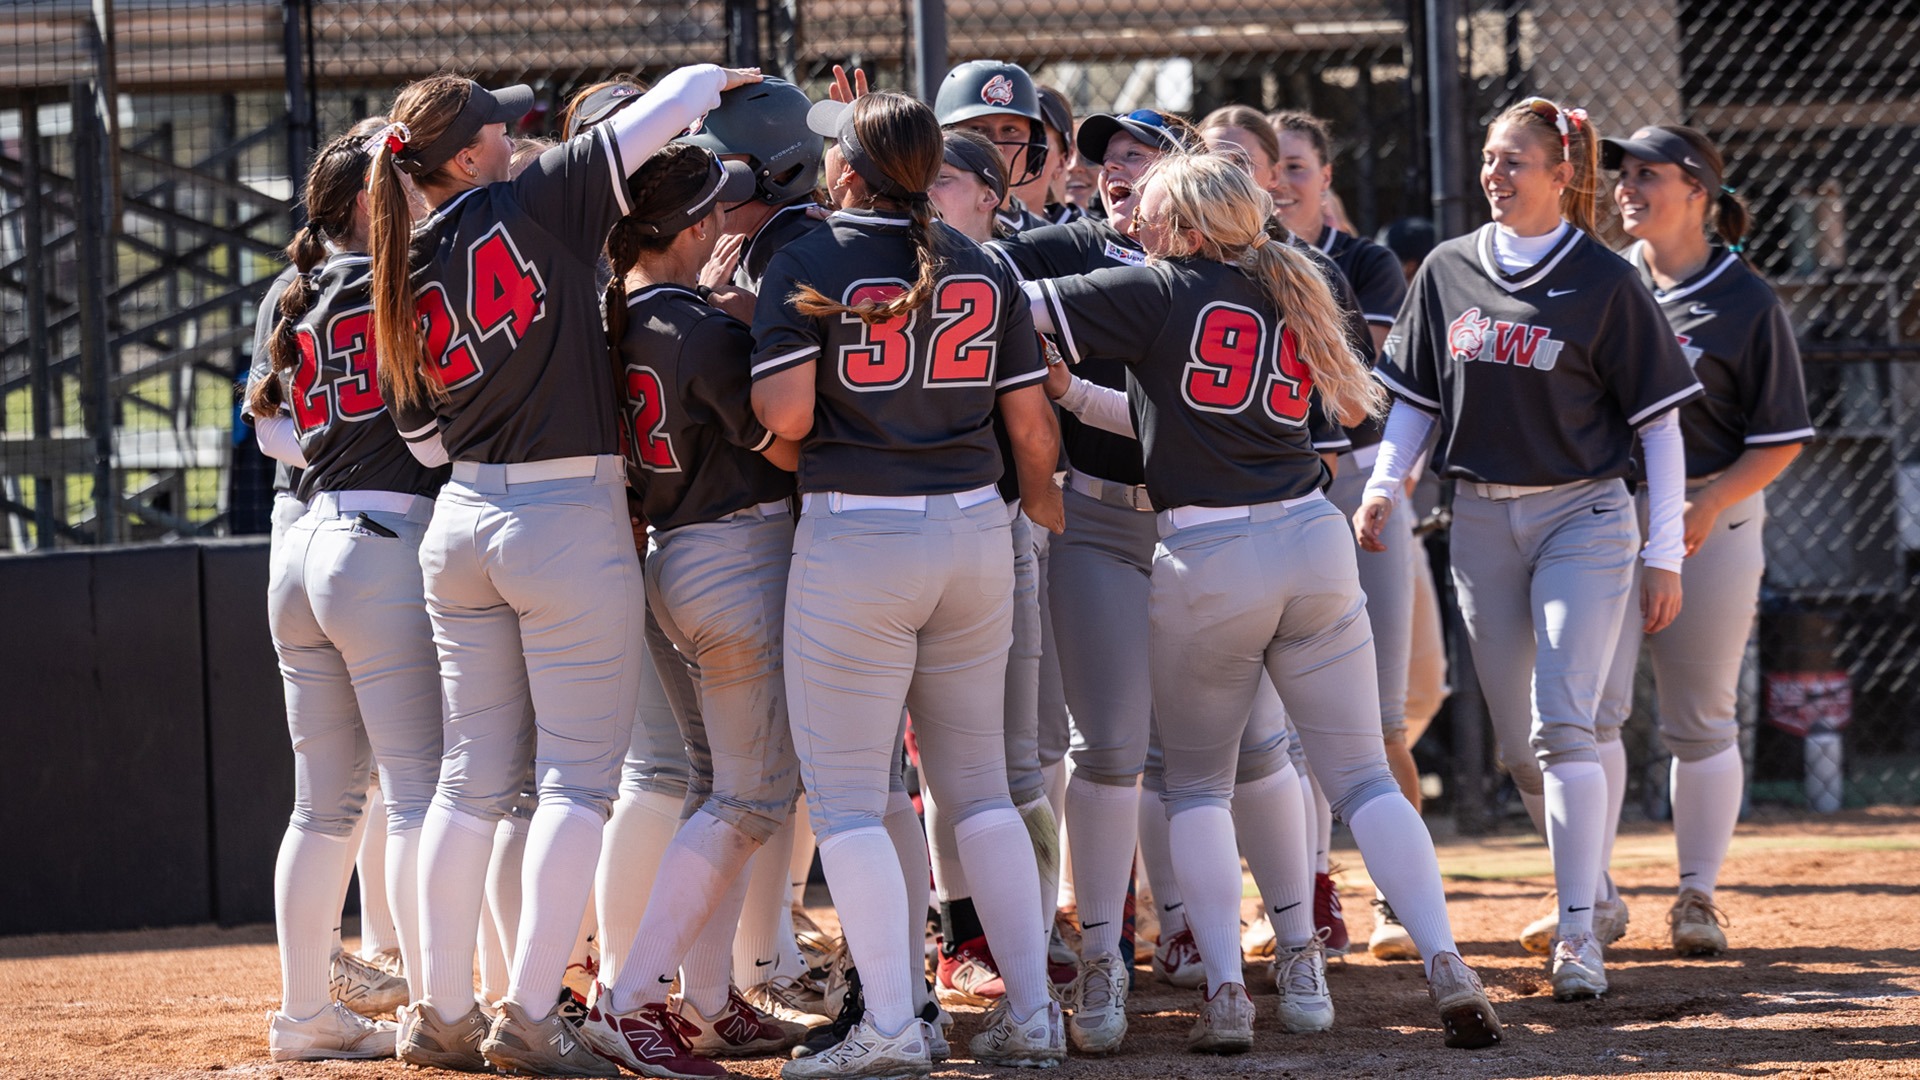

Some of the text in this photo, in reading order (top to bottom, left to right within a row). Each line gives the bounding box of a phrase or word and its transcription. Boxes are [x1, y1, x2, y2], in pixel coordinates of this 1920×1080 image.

[412, 221, 547, 393] 24
[837, 273, 1001, 392] 32
[1477, 320, 1564, 371] IWU
[289, 305, 388, 440] 23
